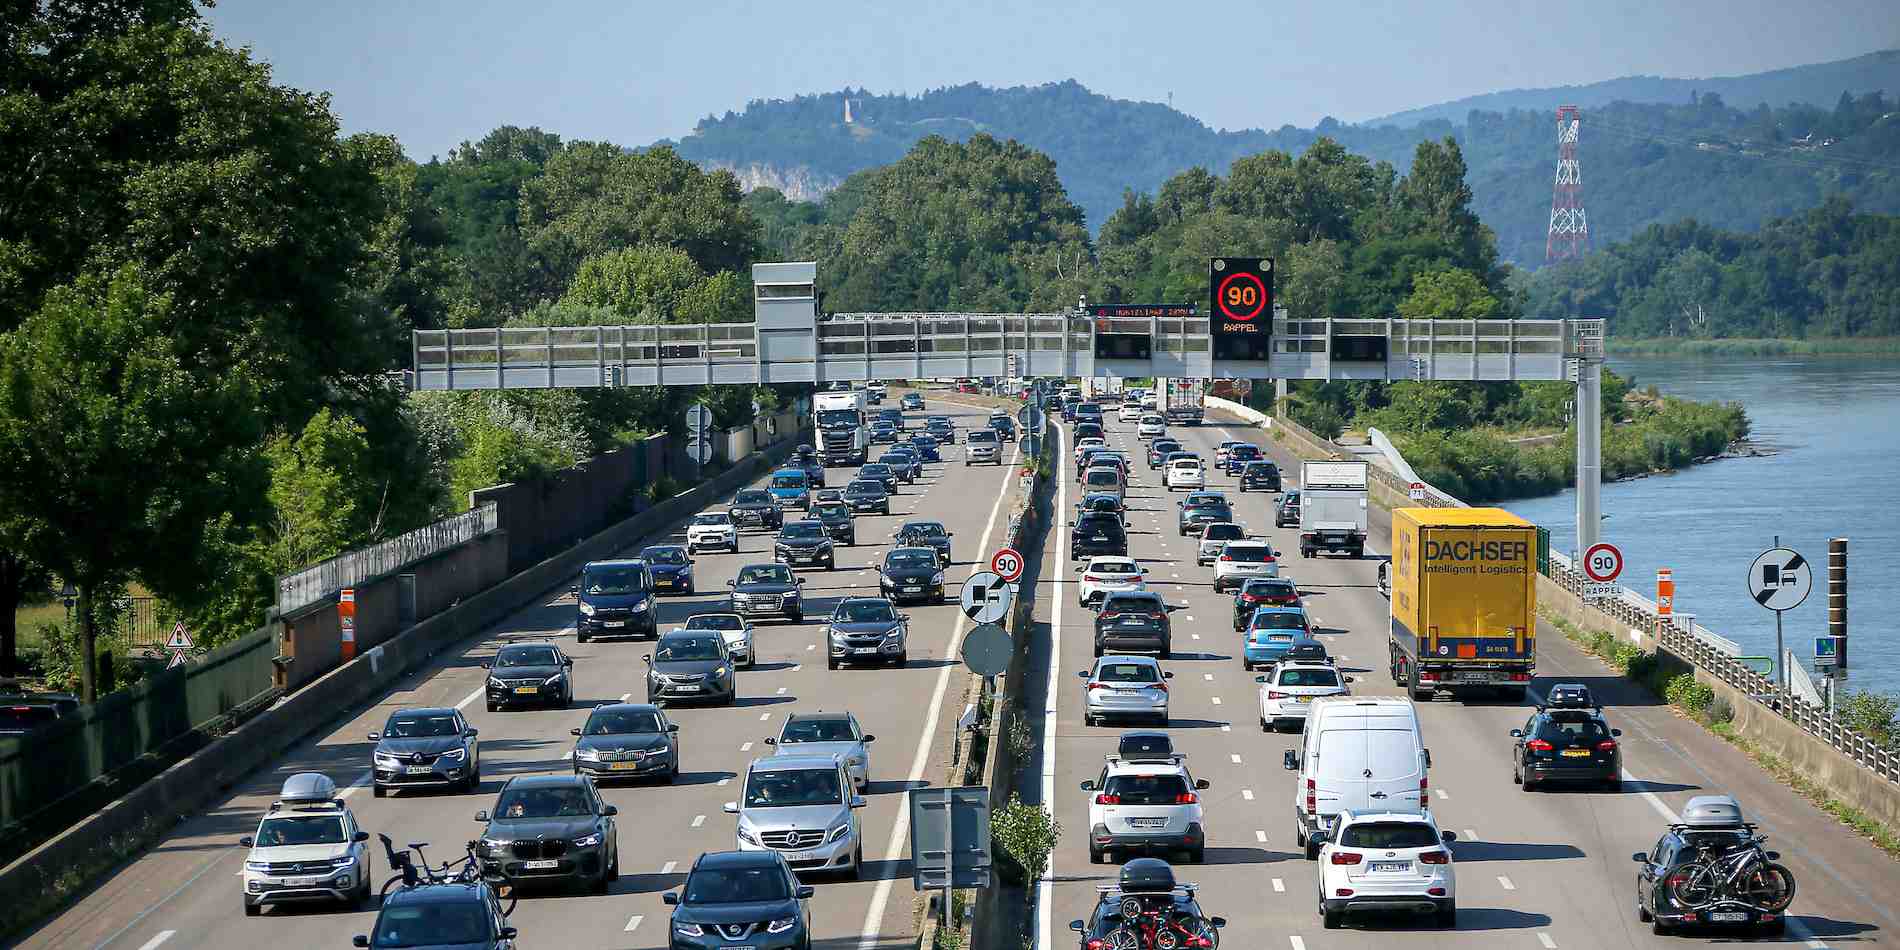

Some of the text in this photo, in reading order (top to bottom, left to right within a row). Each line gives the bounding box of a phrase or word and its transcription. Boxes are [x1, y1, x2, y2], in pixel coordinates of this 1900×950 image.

[1227, 286, 1256, 306] 90
[1223, 323, 1258, 332] RAPPEL
[1424, 541, 1528, 561] DACHSER
[998, 559, 1016, 571] 90
[1594, 557, 1613, 569] 90
[1424, 564, 1528, 575] Intelligent Logistics
[1585, 586, 1622, 594] RAPPEL
